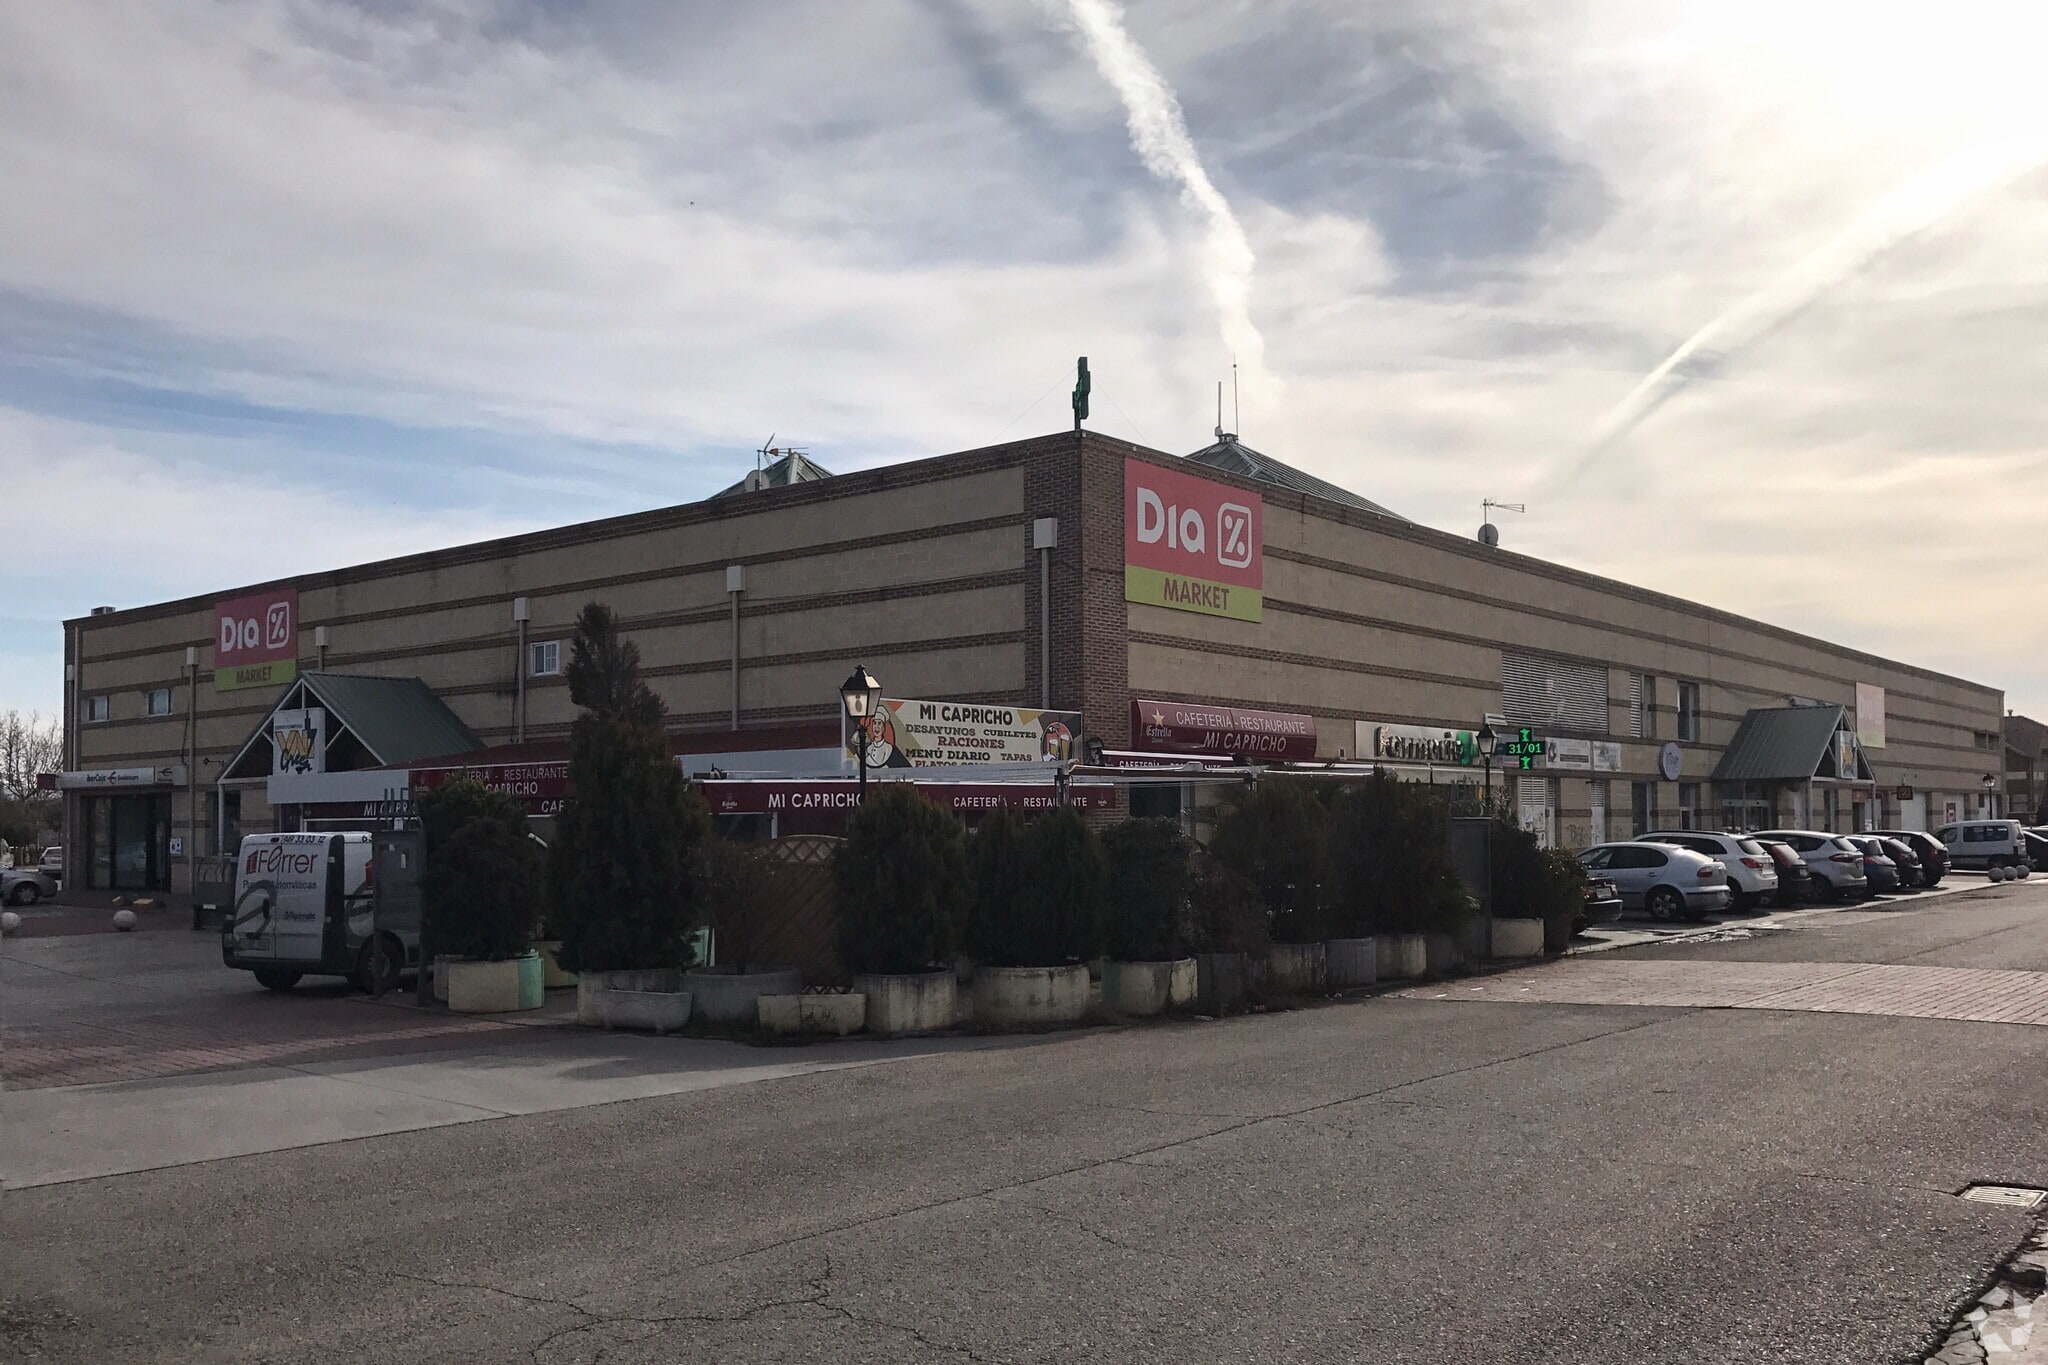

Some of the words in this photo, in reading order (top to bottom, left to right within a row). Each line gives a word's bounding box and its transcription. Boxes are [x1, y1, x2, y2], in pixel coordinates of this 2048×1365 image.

[1164, 577, 1229, 610] MARKET
[236, 666, 272, 684] MARKET
[920, 704, 936, 720] MI
[942, 706, 1013, 726] CAPRICHO
[1175, 711, 1233, 729] CAFETERIA
[1240, 716, 1307, 734] RESTAURANTE
[905, 724, 976, 736] DESAYUNOS
[983, 729, 1037, 739] CUBILETES
[938, 736, 1005, 749] RACIONES
[1203, 731, 1219, 748] MI
[1223, 732, 1287, 751] CAPRICHO
[1508, 743, 1542, 754] 31/01
[905, 747, 943, 759] MENÚ
[947, 751, 991, 761] DIARIO
[1001, 753, 1033, 761] TAPAS
[504, 767, 568, 780] RESTAURANTE
[768, 794, 785, 808] MI
[363, 802, 377, 816] MI
[258, 846, 318, 874] Ferrer
